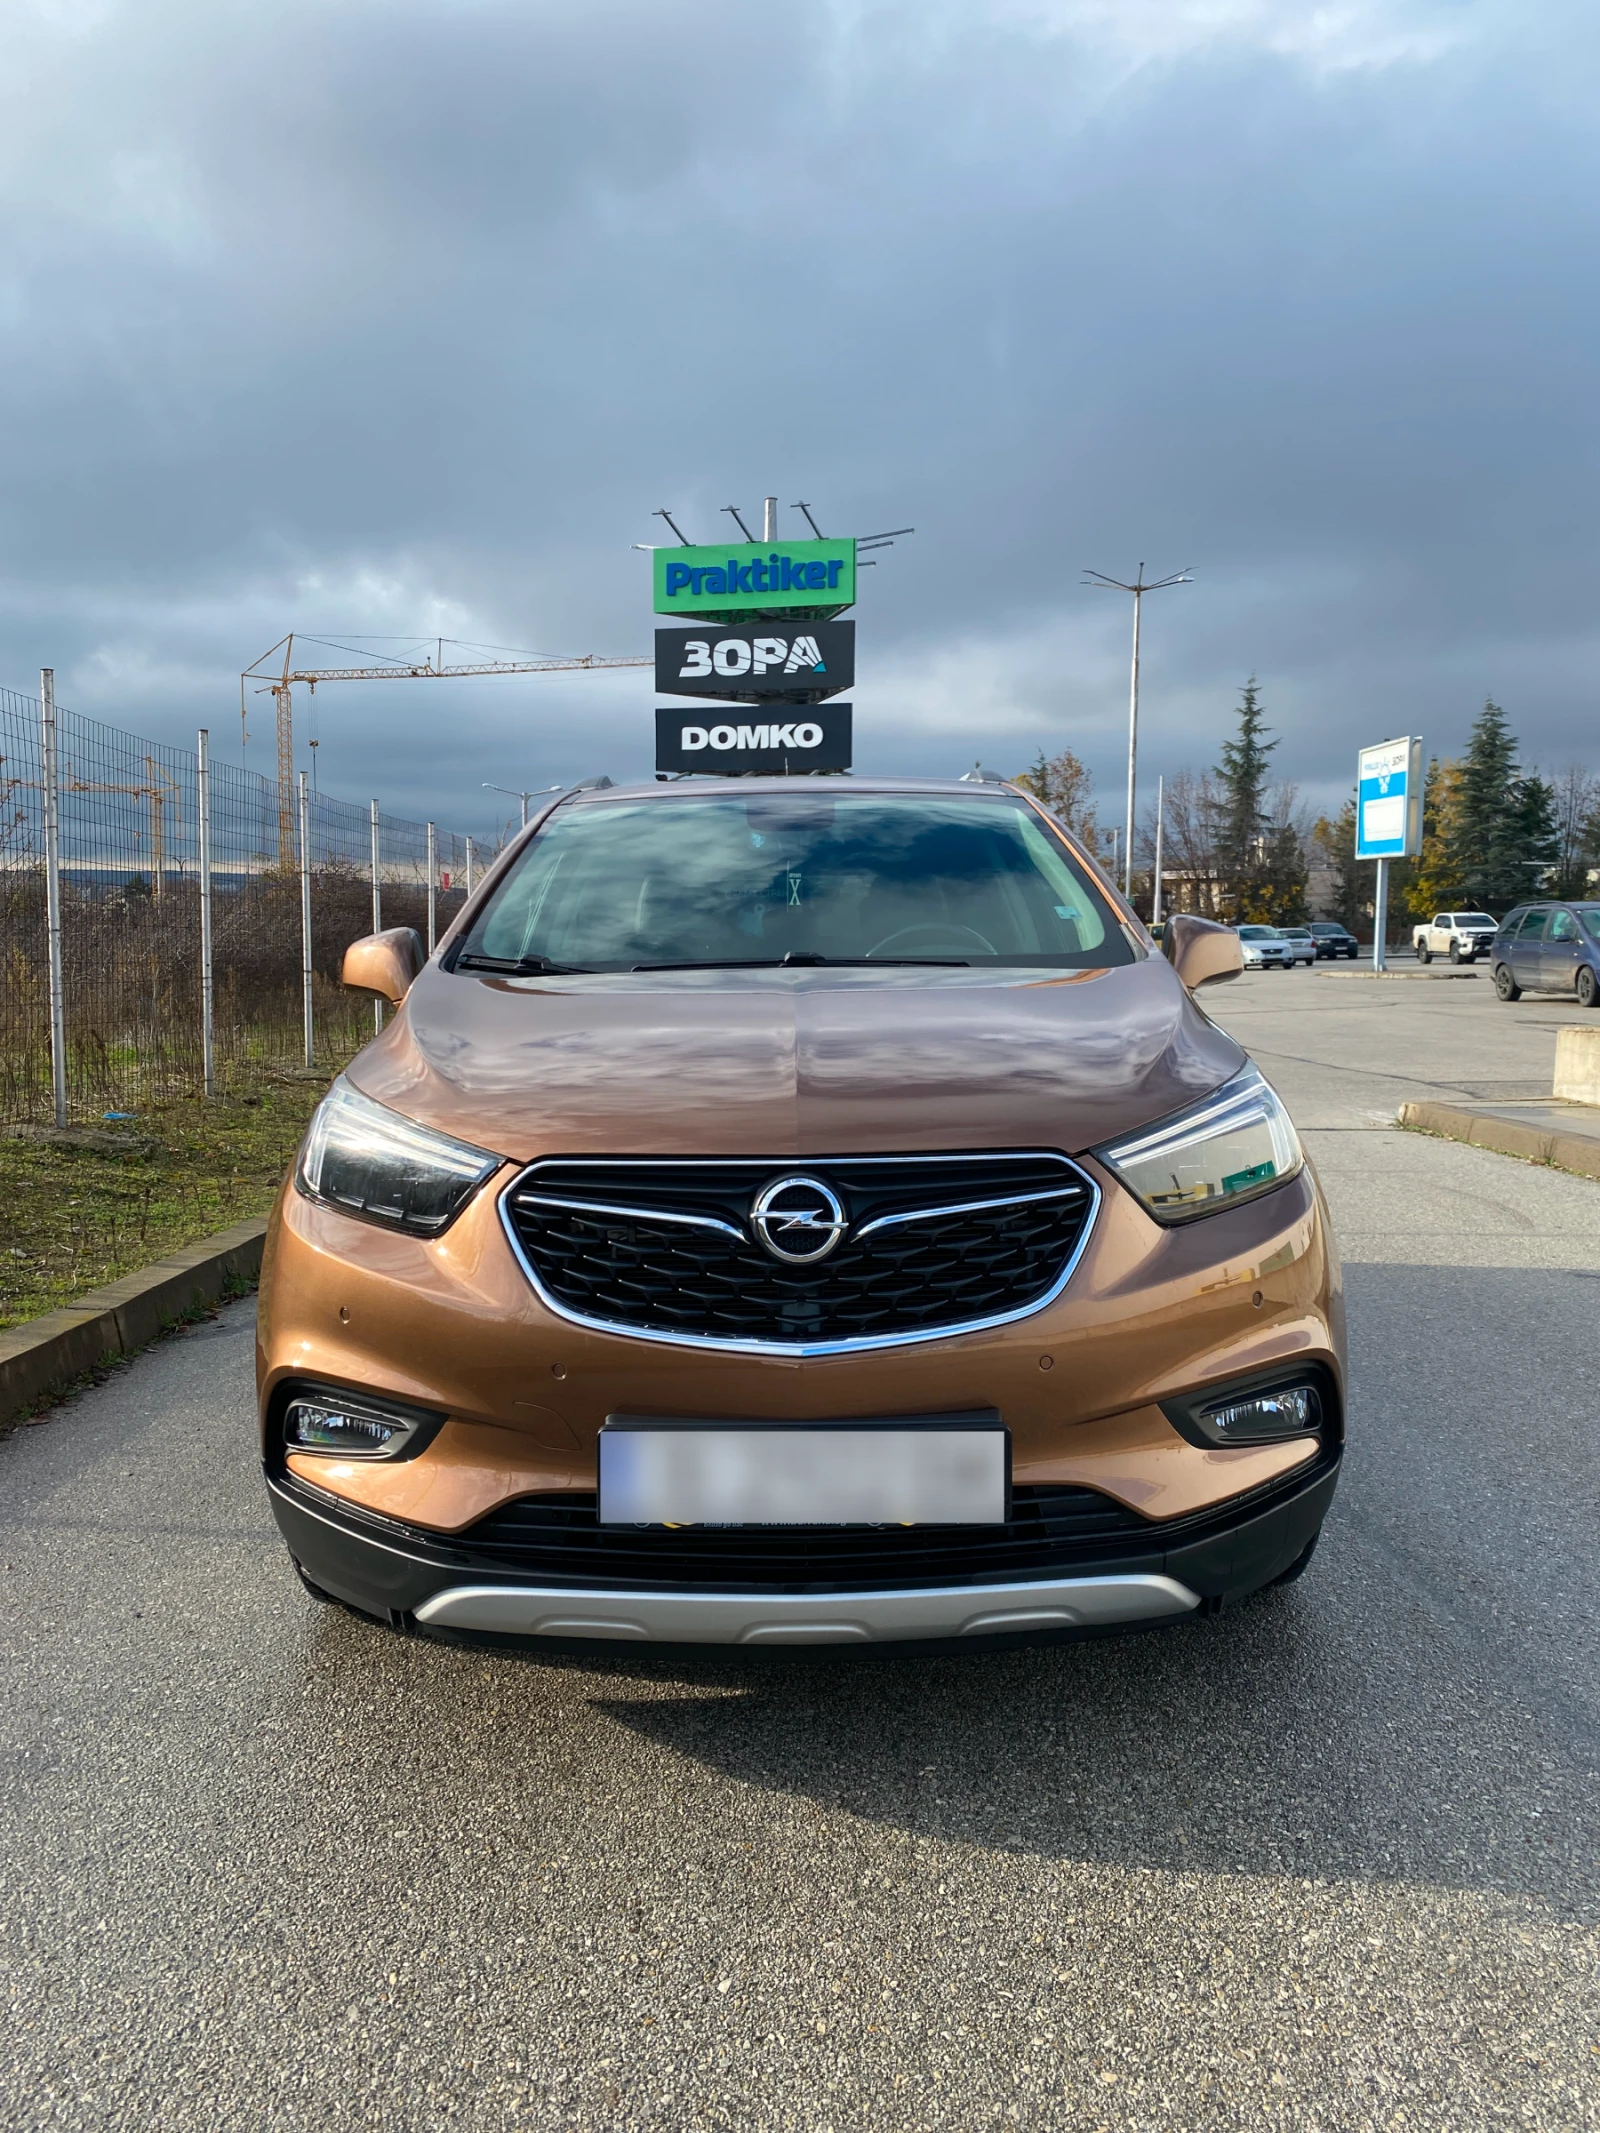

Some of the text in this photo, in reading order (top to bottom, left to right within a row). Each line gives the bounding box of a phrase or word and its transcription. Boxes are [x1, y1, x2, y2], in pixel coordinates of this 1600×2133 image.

[666, 553, 843, 597] Praktiker
[678, 636, 827, 678] ЗОРА
[681, 723, 824, 751] DOMKO
